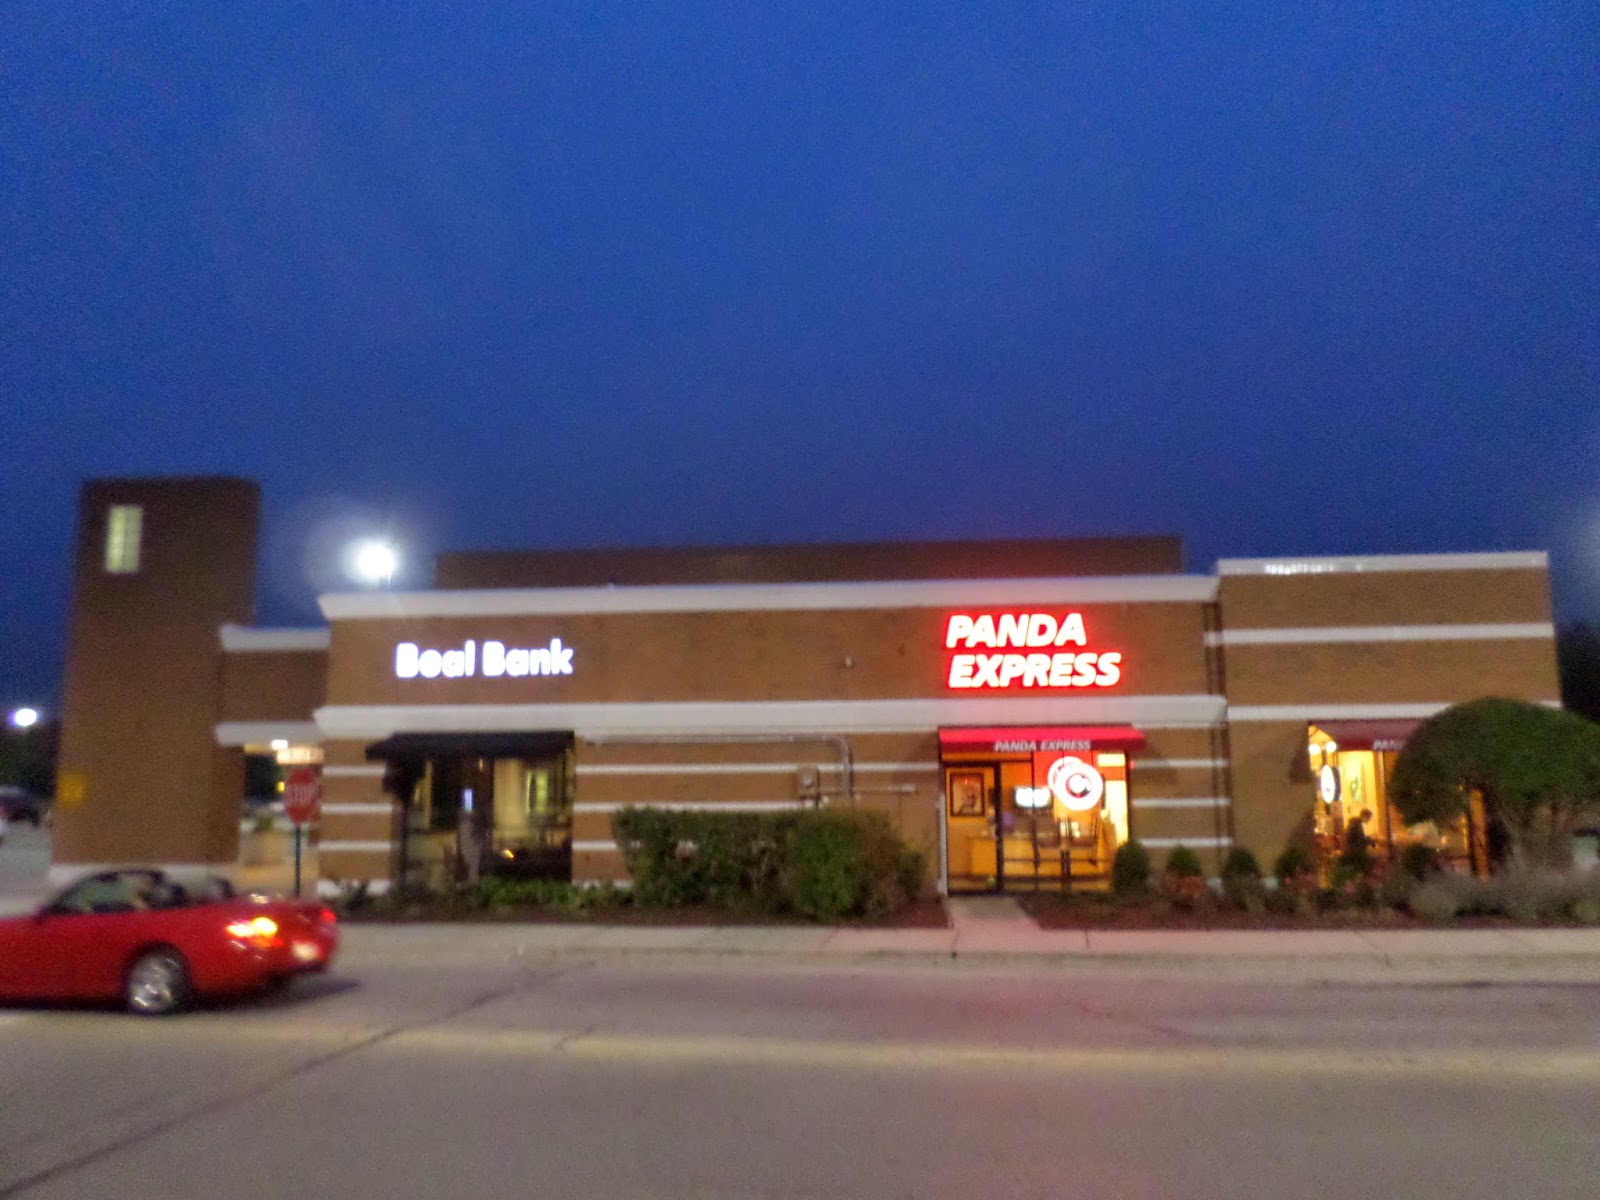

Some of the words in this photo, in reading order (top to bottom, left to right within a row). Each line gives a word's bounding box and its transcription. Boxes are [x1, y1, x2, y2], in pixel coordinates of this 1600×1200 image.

[945, 612, 1087, 648] PANDA
[482, 638, 574, 676] Bank
[948, 652, 1121, 688] EXPRESS
[994, 740, 1037, 752] PANDA
[1040, 739, 1091, 751] EXPRESS
